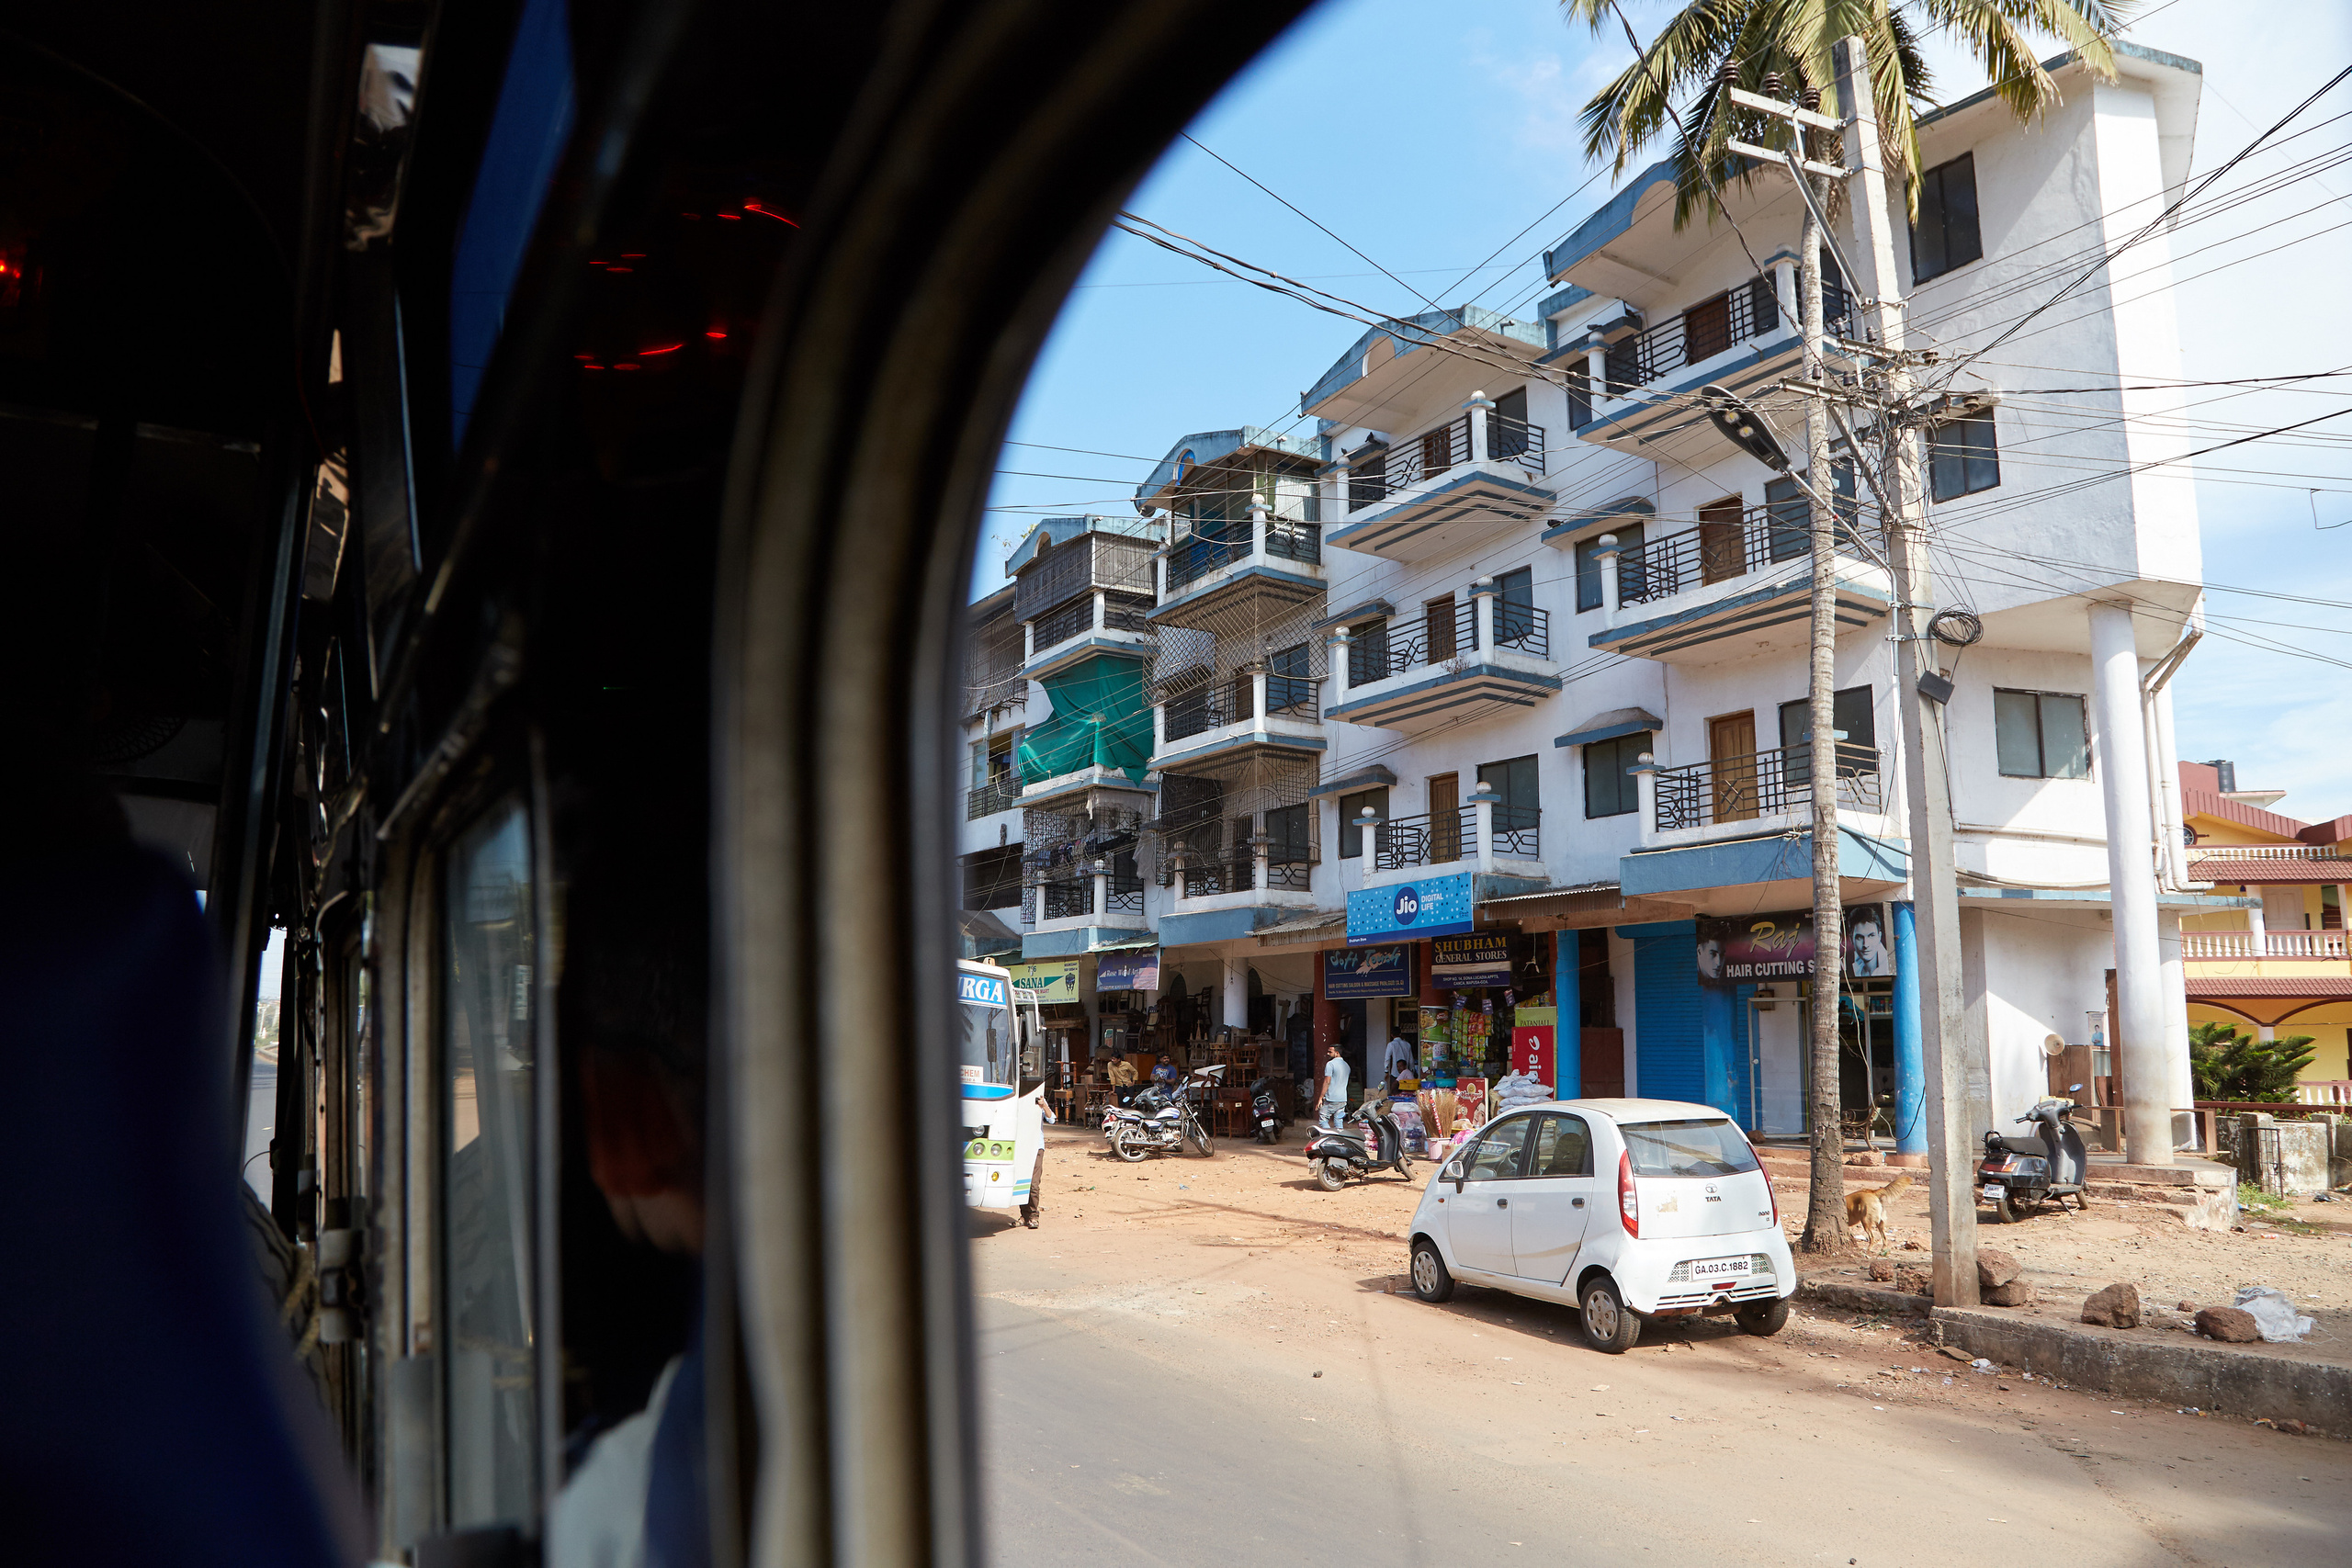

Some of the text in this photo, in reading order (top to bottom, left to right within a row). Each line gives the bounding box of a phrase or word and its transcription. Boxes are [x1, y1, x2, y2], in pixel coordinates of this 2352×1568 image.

[1396, 896, 1417, 915] Jio
[1420, 893, 1444, 903] DIGITAL
[1420, 902, 1434, 911] LIFE
[1434, 936, 1507, 953] SHUBHAM
[1749, 921, 1801, 958] Raj
[1329, 946, 1401, 970] Soft Touch
[1435, 950, 1507, 964] GENERAL STORES
[1726, 964, 1753, 978] HAIR
[1755, 960, 1805, 976] CUTTING
[958, 976, 1003, 1003] RGA
[1020, 976, 1044, 989] SANA
[1694, 1261, 1748, 1275] GA.03.C.1882
